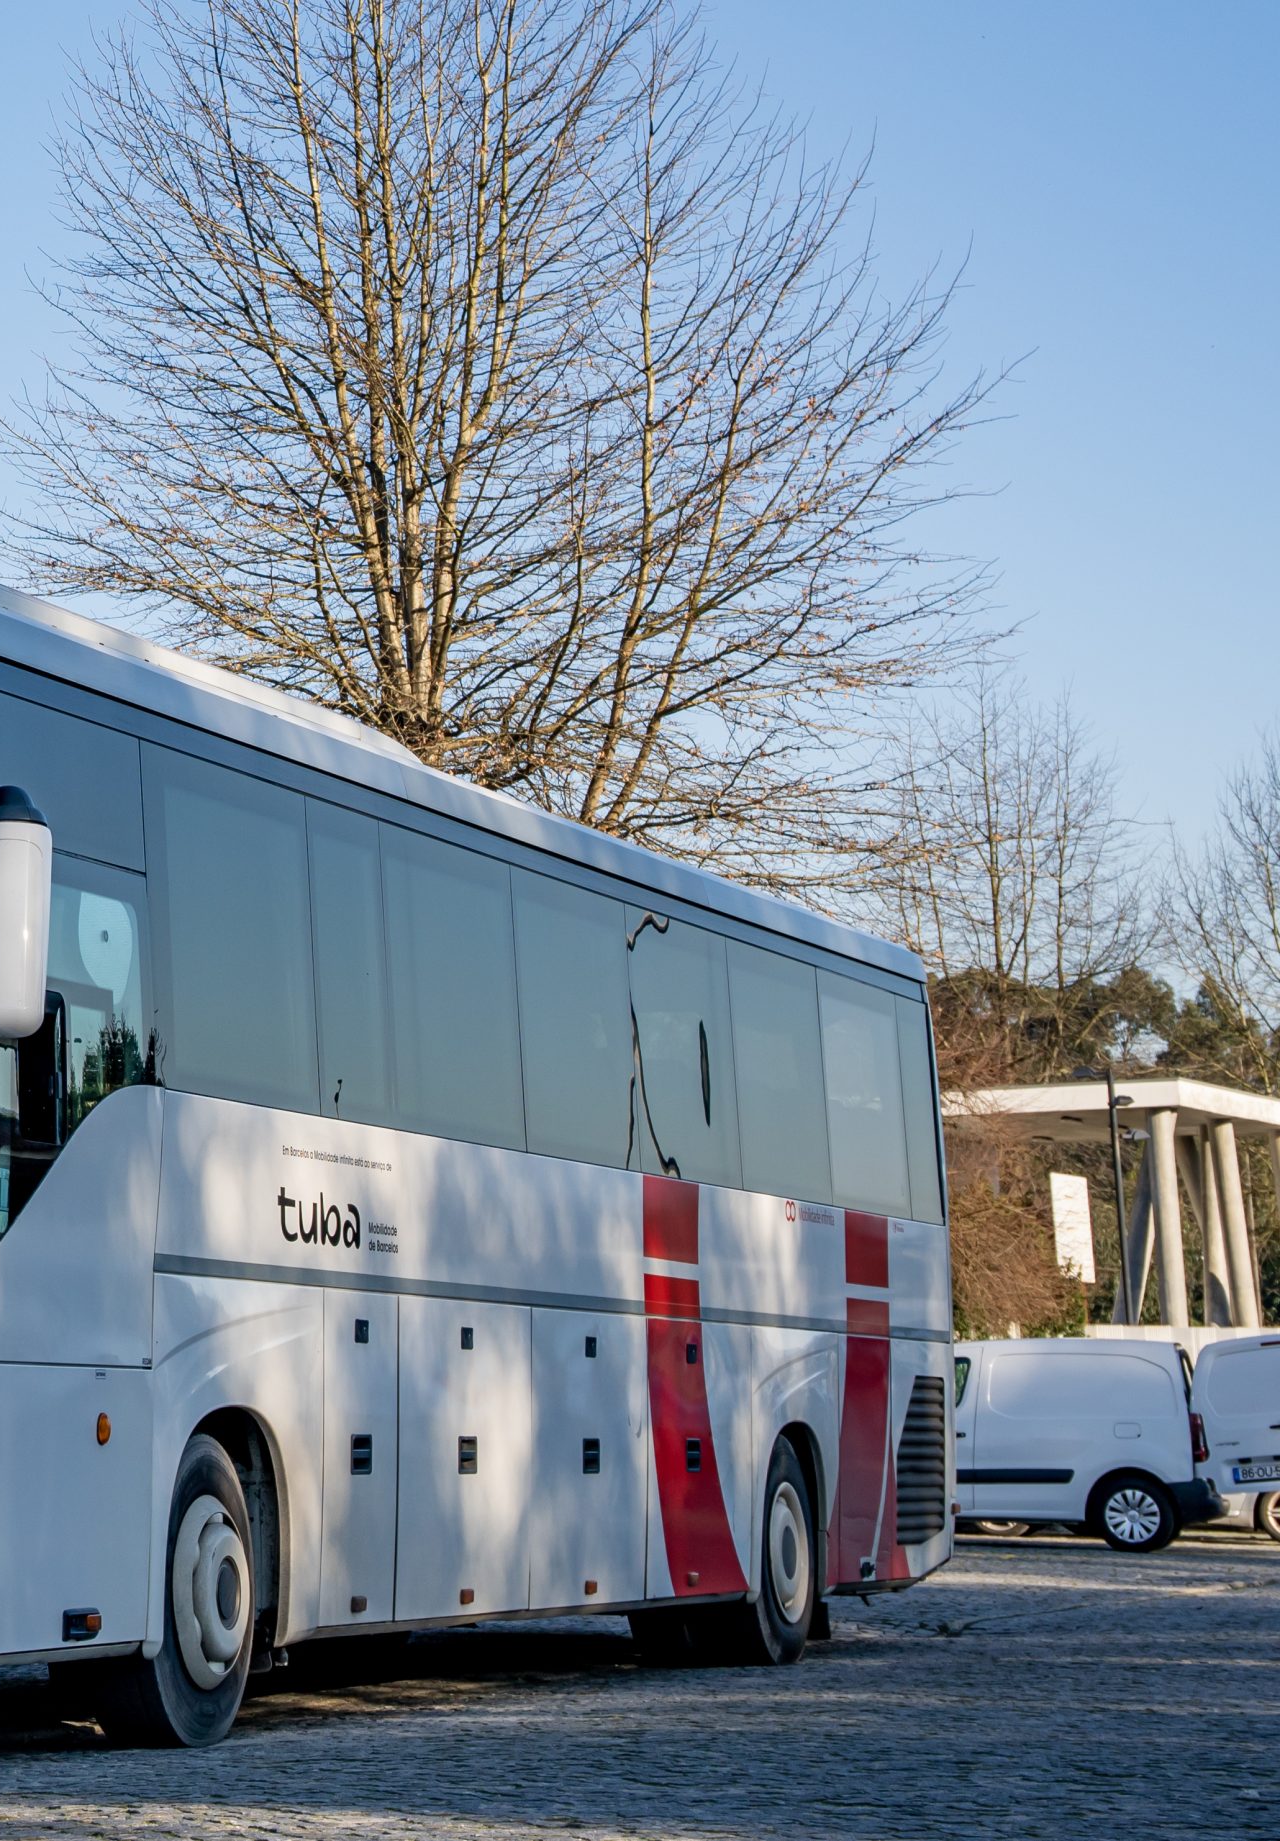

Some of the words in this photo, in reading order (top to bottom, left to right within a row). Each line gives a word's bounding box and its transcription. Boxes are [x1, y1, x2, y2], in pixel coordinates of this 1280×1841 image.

[282, 1145, 289, 1156] Em
[290, 1146, 309, 1159] Barcelos
[314, 1149, 339, 1163] Mobilidade
[278, 1186, 361, 1249] tuba
[368, 1222, 397, 1236] Mobilidade
[368, 1241, 376, 1251] de
[376, 1240, 398, 1254] Barcelos
